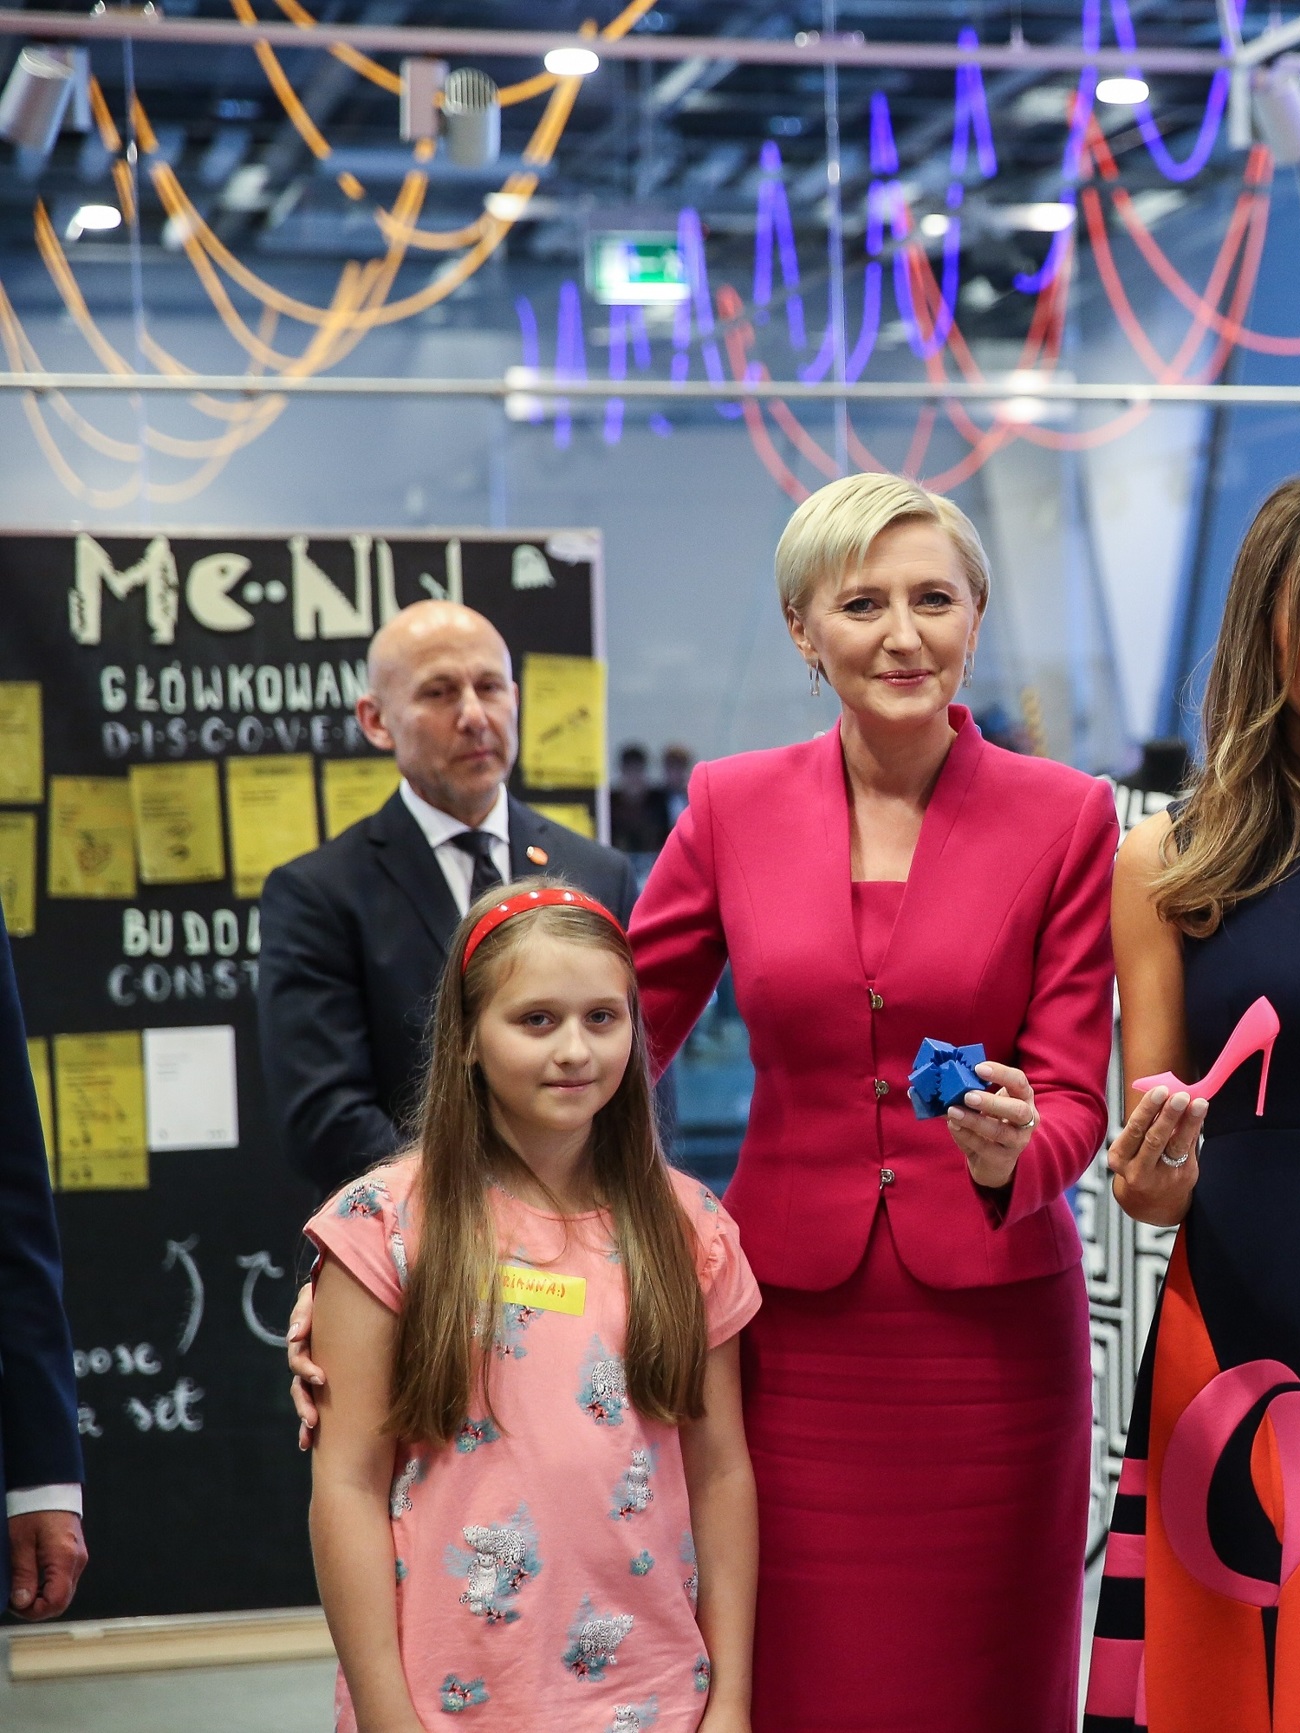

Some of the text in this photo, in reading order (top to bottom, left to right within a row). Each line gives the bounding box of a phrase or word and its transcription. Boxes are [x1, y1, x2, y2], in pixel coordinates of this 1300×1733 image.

[101, 659, 368, 714] GŁÓWKOWAN
[122, 905, 261, 957] BUDO
[107, 958, 260, 1007] CONST
[73, 1342, 163, 1378] oose
[124, 1377, 206, 1433] set
